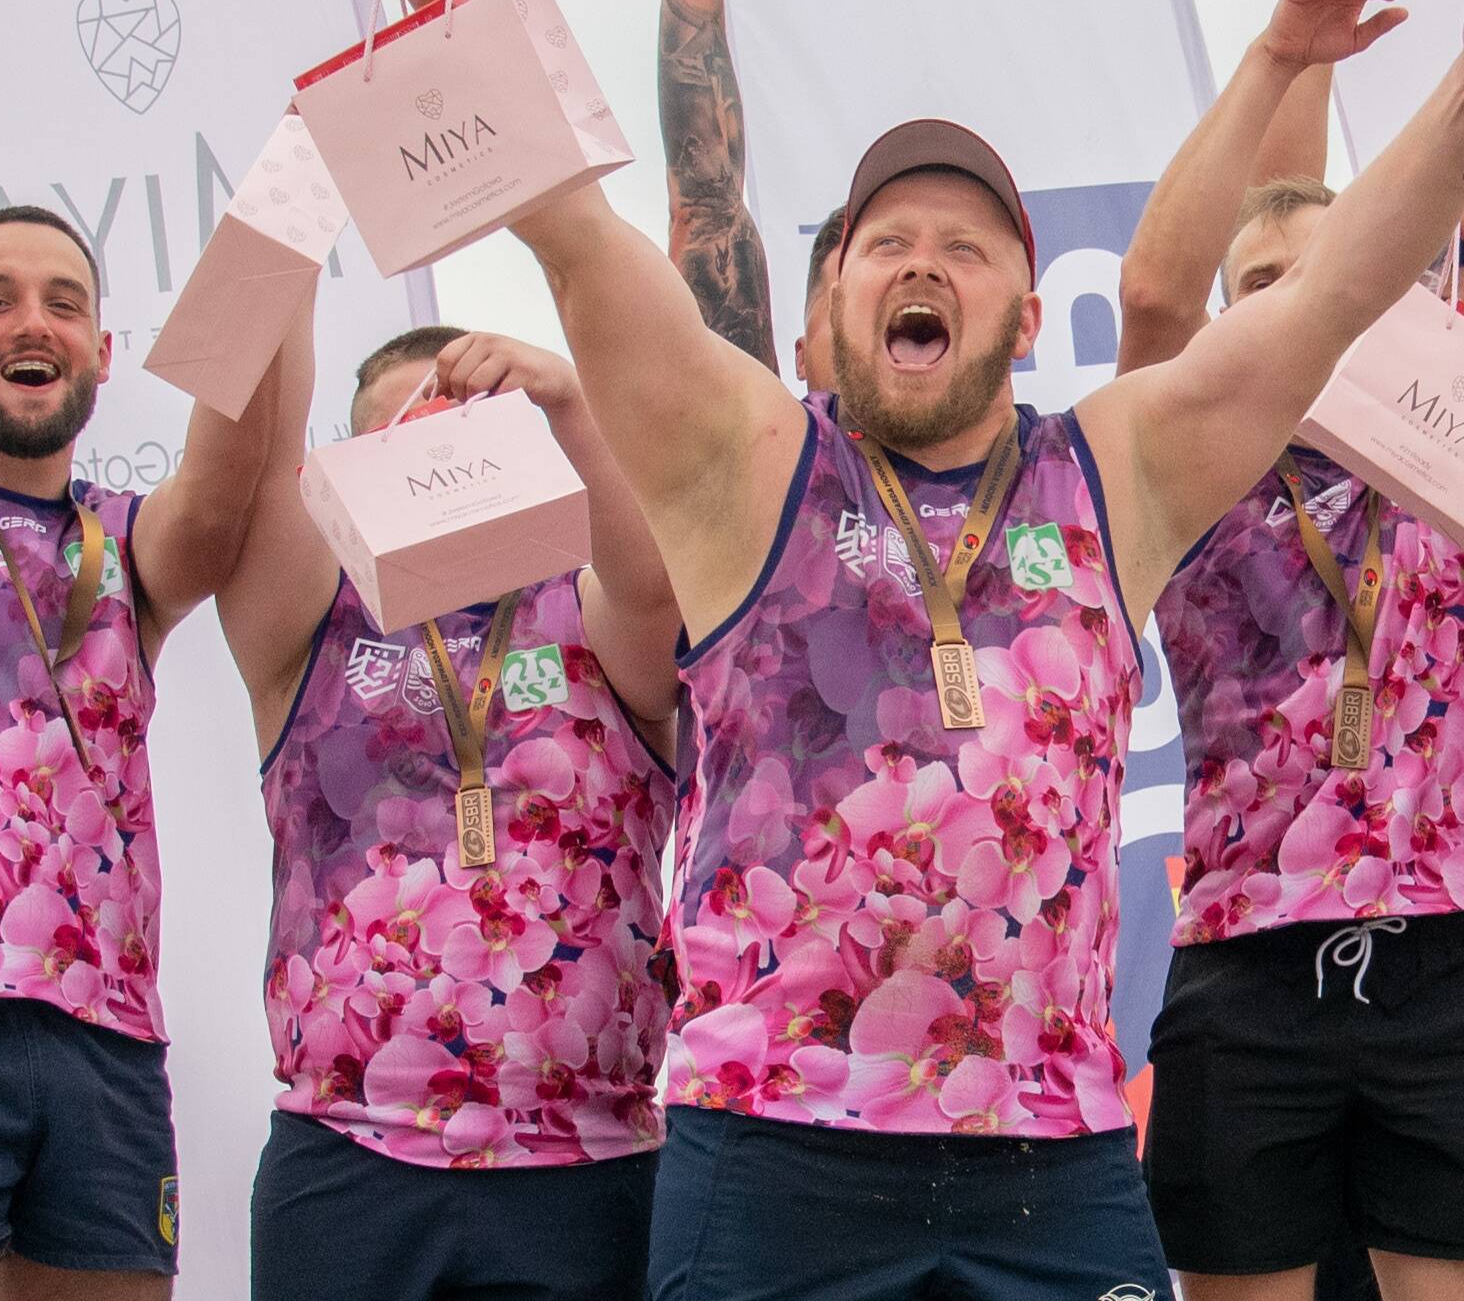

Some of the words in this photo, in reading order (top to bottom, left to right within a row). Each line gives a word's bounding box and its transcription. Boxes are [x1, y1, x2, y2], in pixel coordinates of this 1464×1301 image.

[399, 114, 497, 181] MIYA
[406, 458, 502, 497] MIYA
[443, 635, 482, 654] ERA
[943, 649, 962, 684] SBR
[1343, 692, 1360, 725] SBR
[466, 794, 480, 827] SBR
